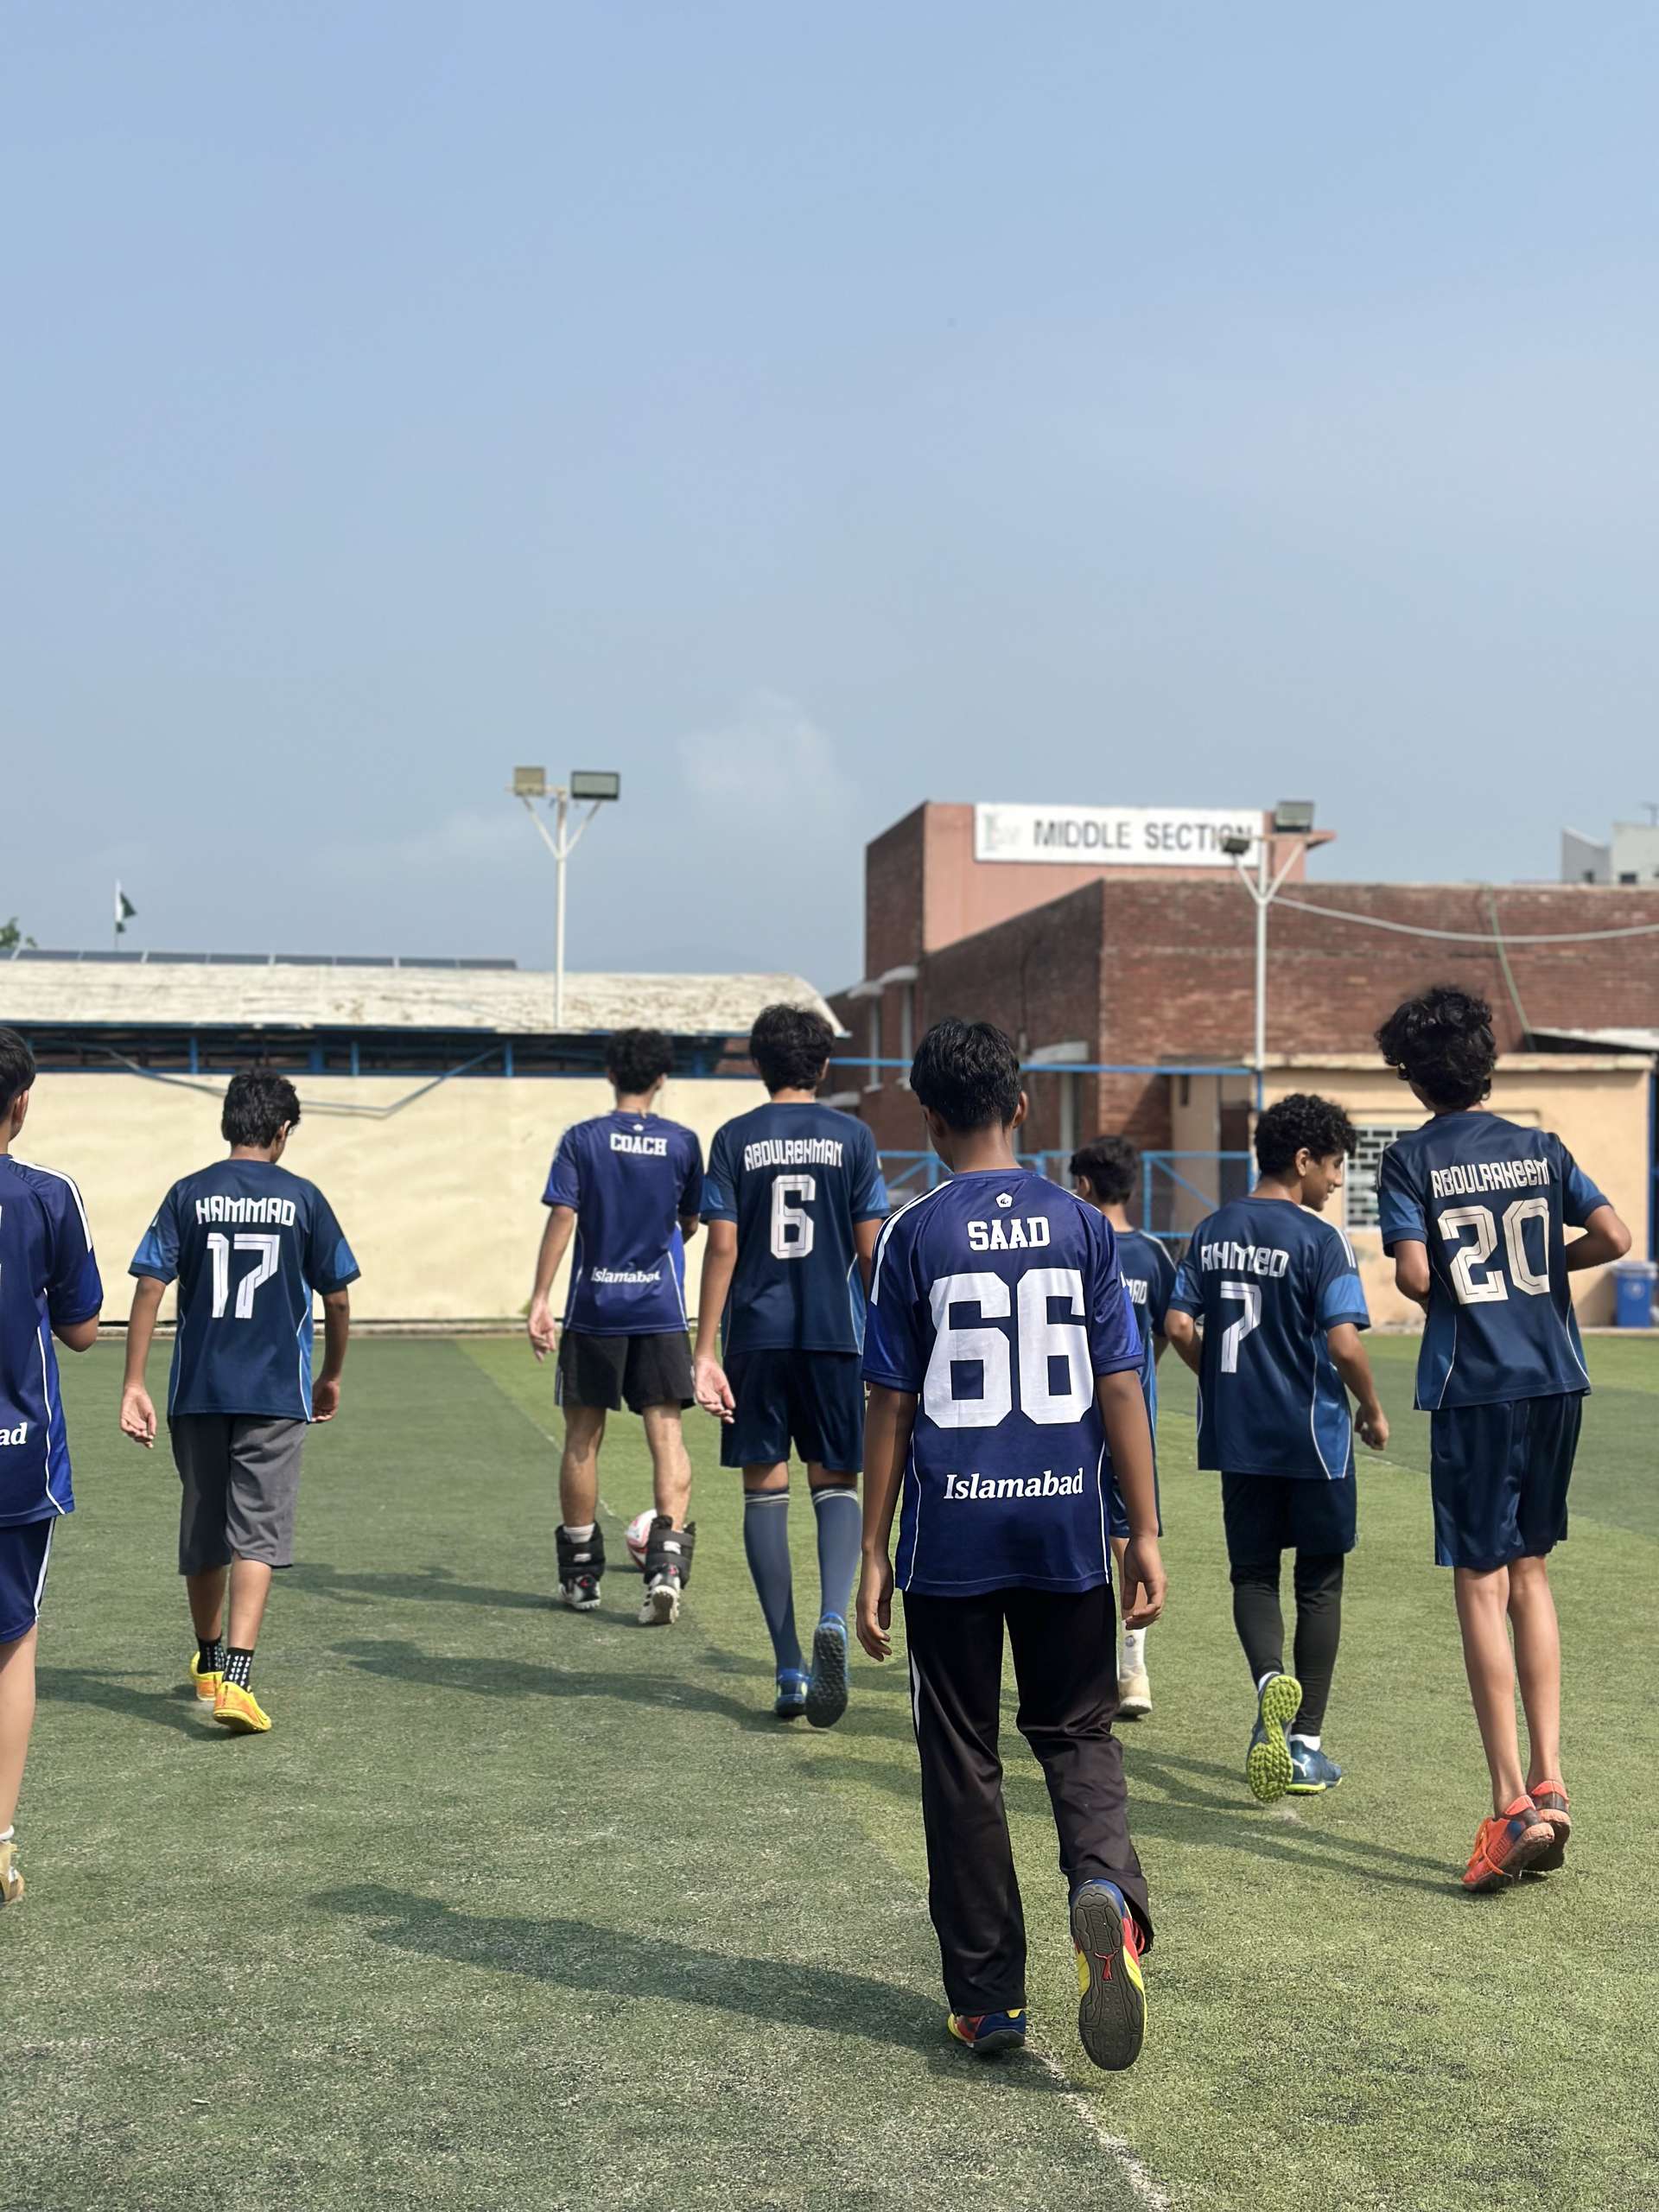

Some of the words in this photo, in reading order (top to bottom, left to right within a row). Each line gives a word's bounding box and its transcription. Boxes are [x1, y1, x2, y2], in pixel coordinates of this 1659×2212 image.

[1033, 820, 1131, 849] MIDDLE
[609, 1133, 668, 1156] COACH
[195, 1195, 296, 1227] HAMMAD
[770, 1174, 816, 1260] 6
[967, 1216, 1051, 1251] SAAD
[1437, 1197, 1550, 1305] 20
[207, 1232, 281, 1319] 17
[1201, 1241, 1290, 1277] AHMED
[1220, 1281, 1262, 1373] 7
[923, 1268, 1095, 1428] 66
[944, 1467, 1084, 1499] Islamabad
